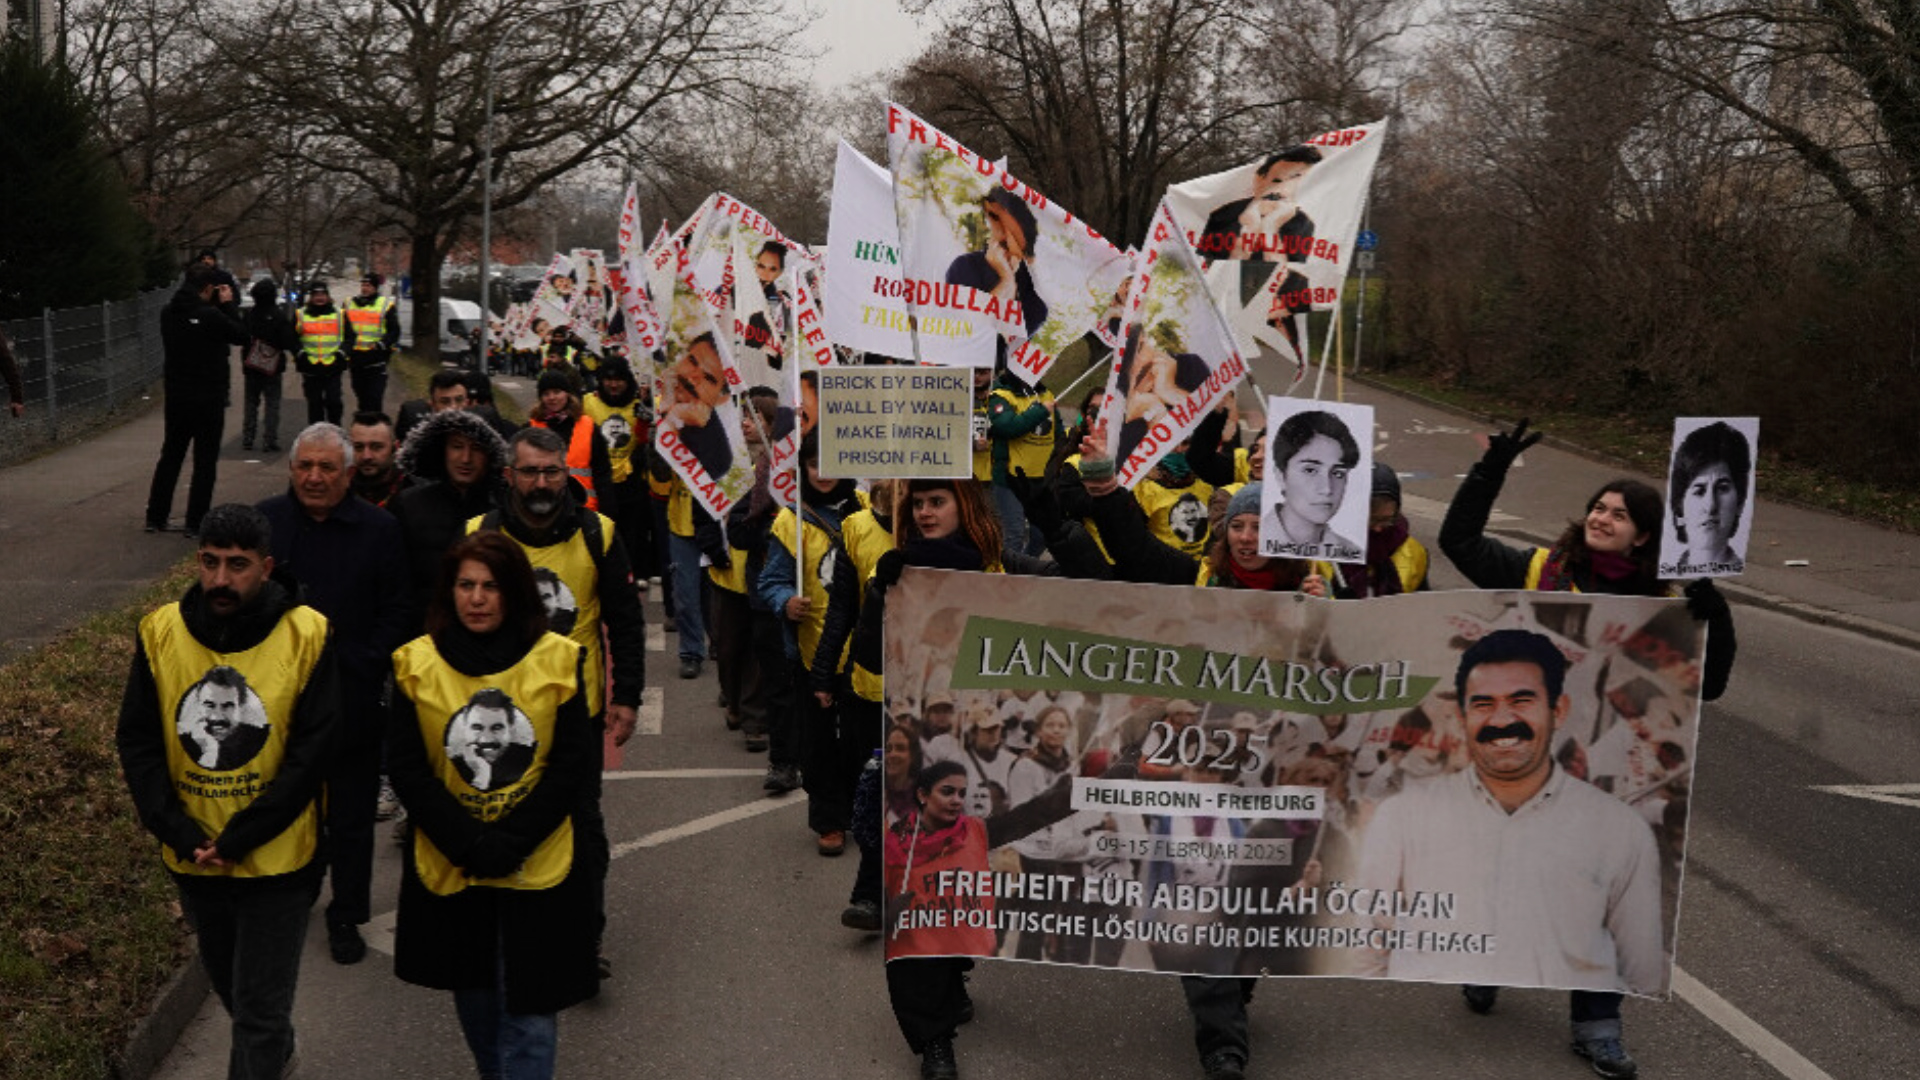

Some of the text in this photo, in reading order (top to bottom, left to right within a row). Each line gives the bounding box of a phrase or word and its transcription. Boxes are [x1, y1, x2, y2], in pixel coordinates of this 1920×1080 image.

[888, 105, 1047, 210] FREEDOM
[903, 278, 1022, 325] BDULLAH
[822, 376, 970, 393] BRICK BY BRICK,
[827, 401, 876, 414] WALL
[882, 401, 905, 414] BY
[836, 425, 887, 440] MAKE
[838, 451, 953, 466] PRISON FALL
[978, 636, 1413, 705] LANGER MARSCH
[1146, 721, 1269, 773] 2025
[1085, 787, 1201, 809] HEILBRONN
[1216, 792, 1316, 812] FREIBURG
[1096, 836, 1287, 861] 09-15 FEBRUAR 2025
[936, 870, 1076, 902] FREIHEIT
[1082, 872, 1144, 908] FÜR
[1151, 881, 1319, 916] ABDULLAH
[1325, 880, 1458, 919] ÖCALAN
[897, 909, 1497, 954] EINE POLITISCHE LÖSUNG FÜR DIE KURDISCHE FRAGE
